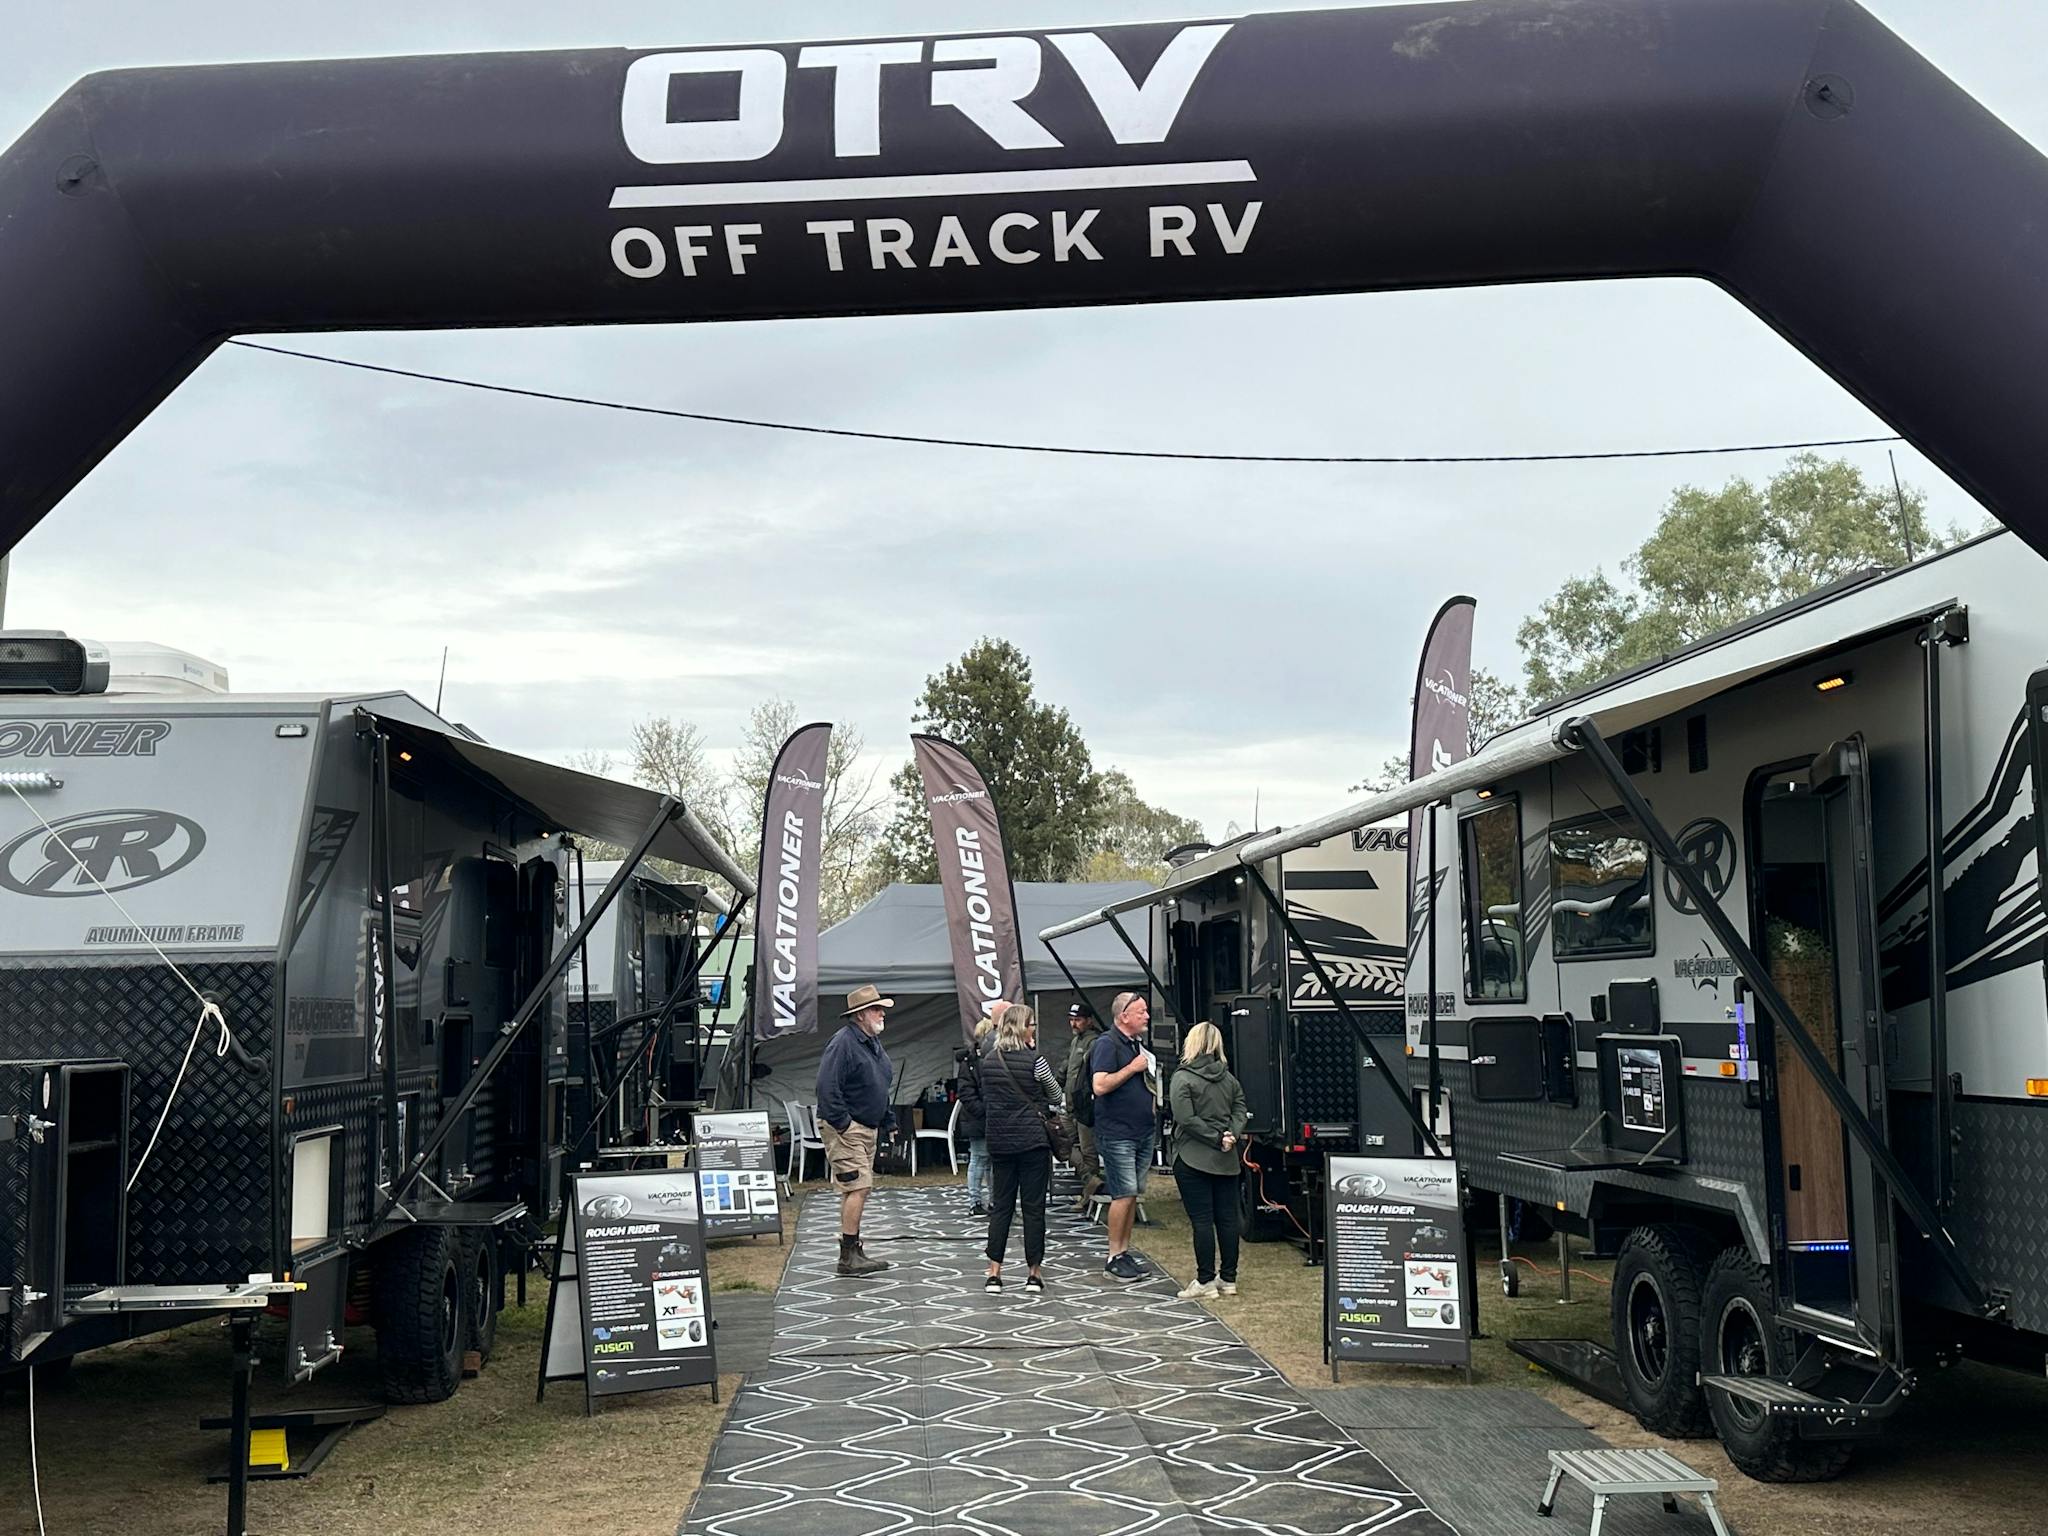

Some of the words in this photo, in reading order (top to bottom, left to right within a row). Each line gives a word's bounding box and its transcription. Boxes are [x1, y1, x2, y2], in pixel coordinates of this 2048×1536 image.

[621, 24, 1234, 164] OTRV
[610, 223, 763, 279] OFF
[806, 209, 1104, 273] TRACK
[1149, 201, 1263, 259] RV
[777, 774, 822, 790] VACATIONER
[932, 790, 986, 804] VACATIONER
[773, 810, 804, 1028] VACATIONER
[955, 827, 1004, 1018] ACATIONER
[84, 926, 185, 944] ALUMINIUM
[184, 924, 245, 943] FRAME
[1404, 1176, 1453, 1184] VACATIONER
[648, 1190, 693, 1200] VACATIONER
[1336, 1203, 1379, 1214] ROUGH
[1380, 1205, 1416, 1215] RIDER
[585, 1226, 626, 1238] ROUGH
[627, 1224, 661, 1235] RIDER
[1413, 1286, 1430, 1295] XT
[662, 1306, 678, 1316] XT
